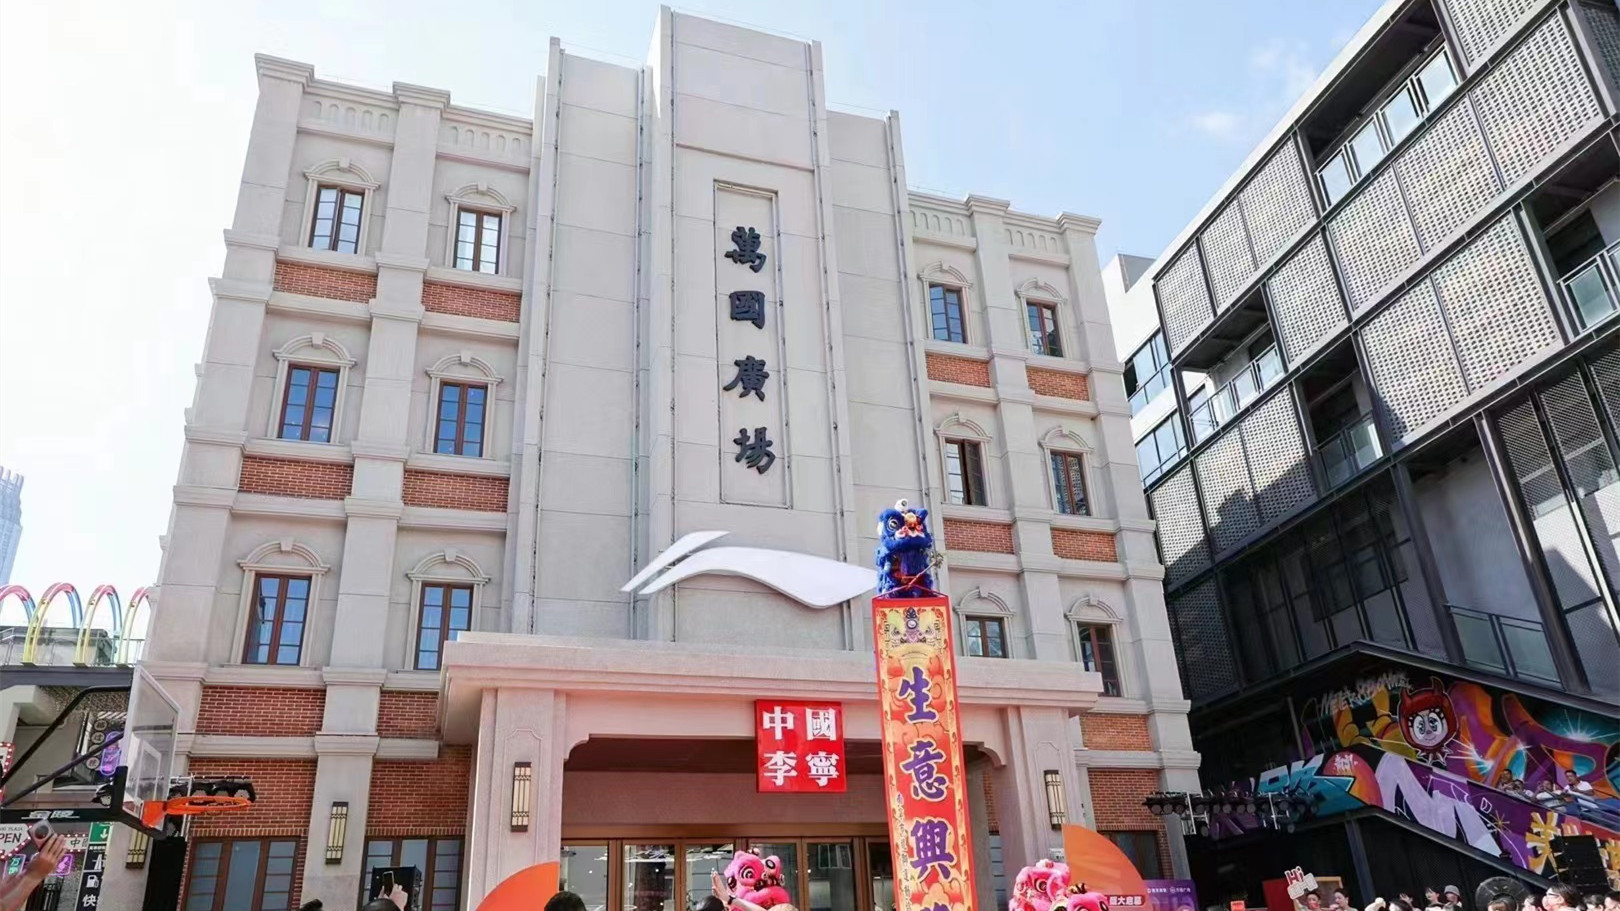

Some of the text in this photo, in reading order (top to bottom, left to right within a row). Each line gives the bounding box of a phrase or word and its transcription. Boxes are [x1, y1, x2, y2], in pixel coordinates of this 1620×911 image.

[723, 226, 776, 475] 萬國廣場
[762, 706, 837, 741] 中國
[763, 750, 840, 787] 李寧
[898, 666, 957, 911] 生意興
